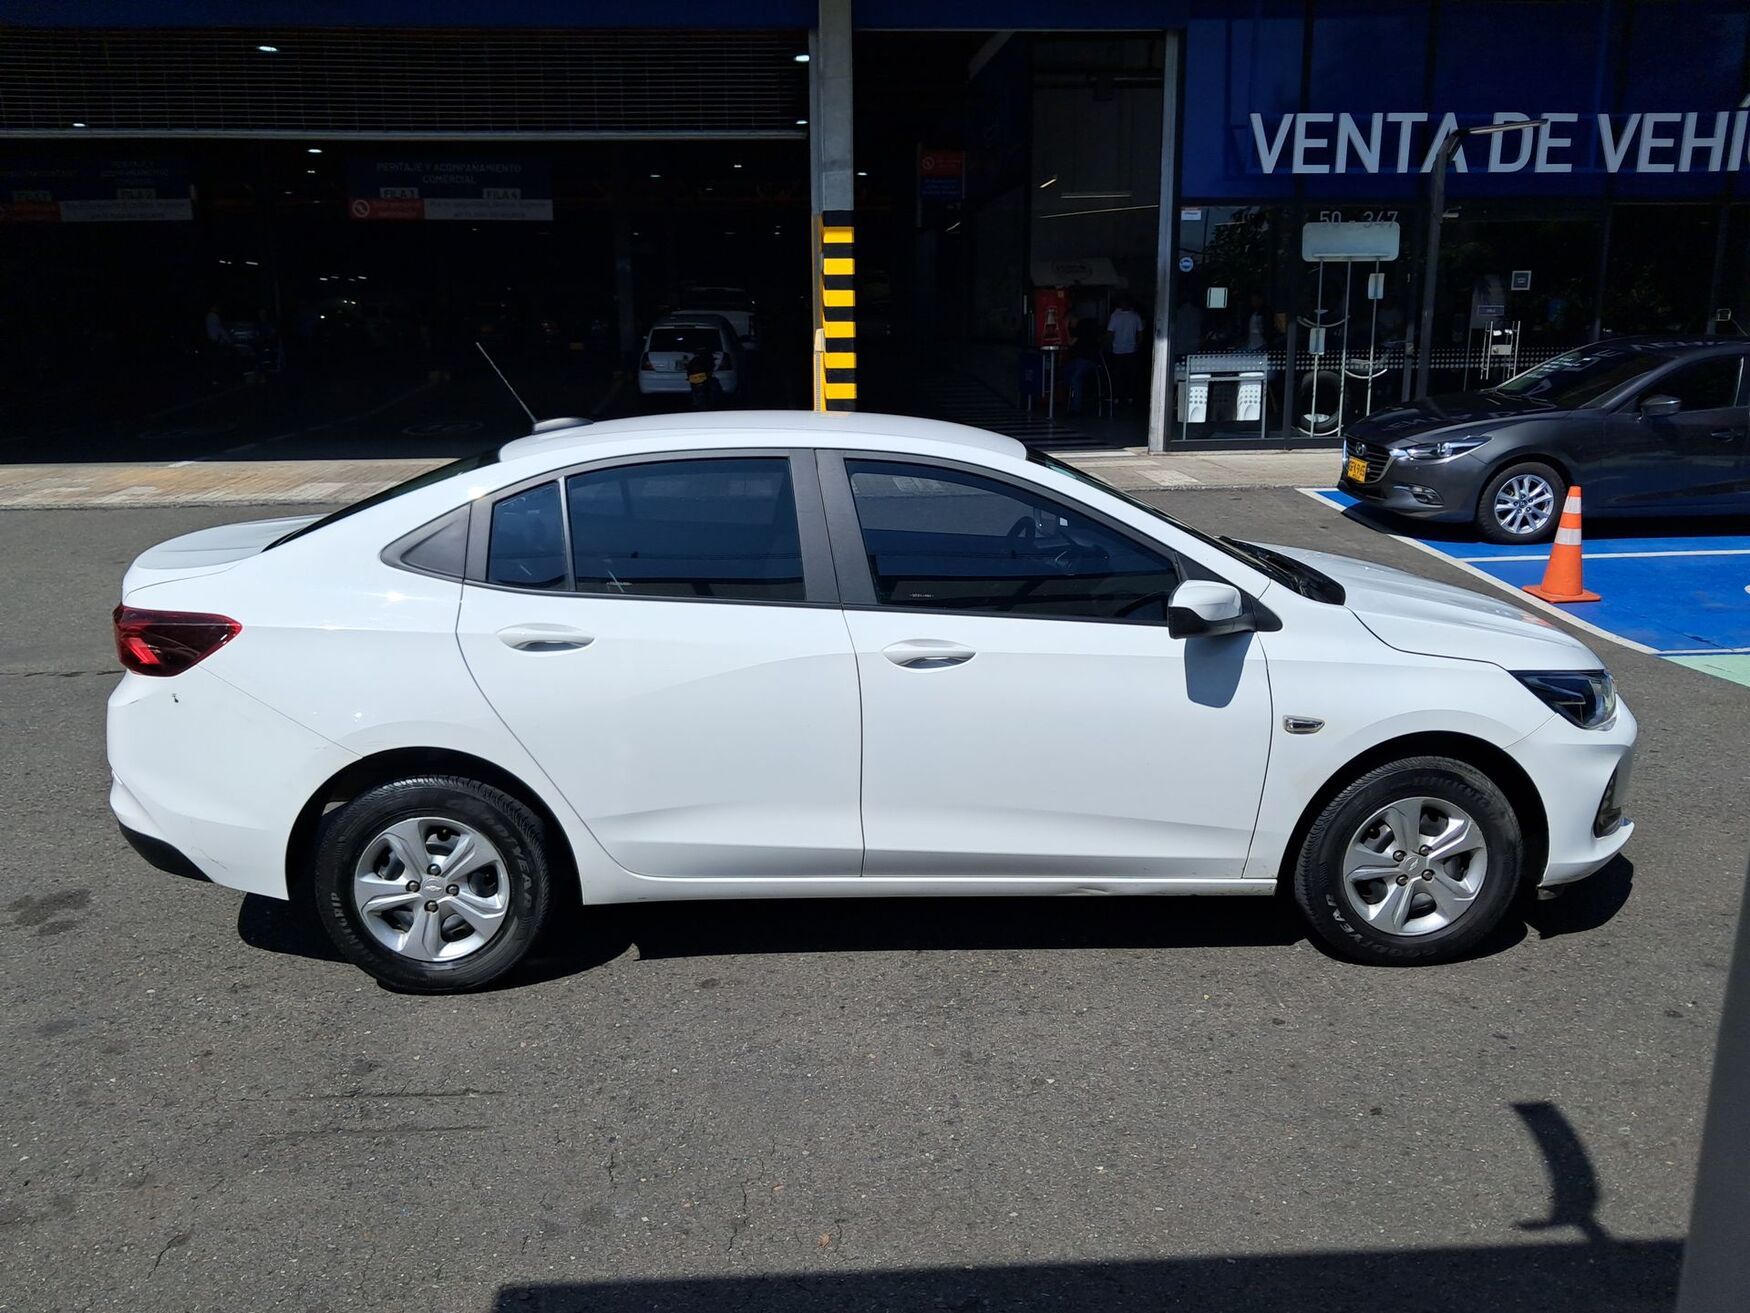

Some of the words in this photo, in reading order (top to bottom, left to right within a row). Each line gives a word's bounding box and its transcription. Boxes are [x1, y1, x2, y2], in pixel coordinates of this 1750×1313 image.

[1250, 112, 1469, 174] VENTA
[1488, 111, 1578, 173] DE
[1597, 94, 1750, 173] VEHÍ
